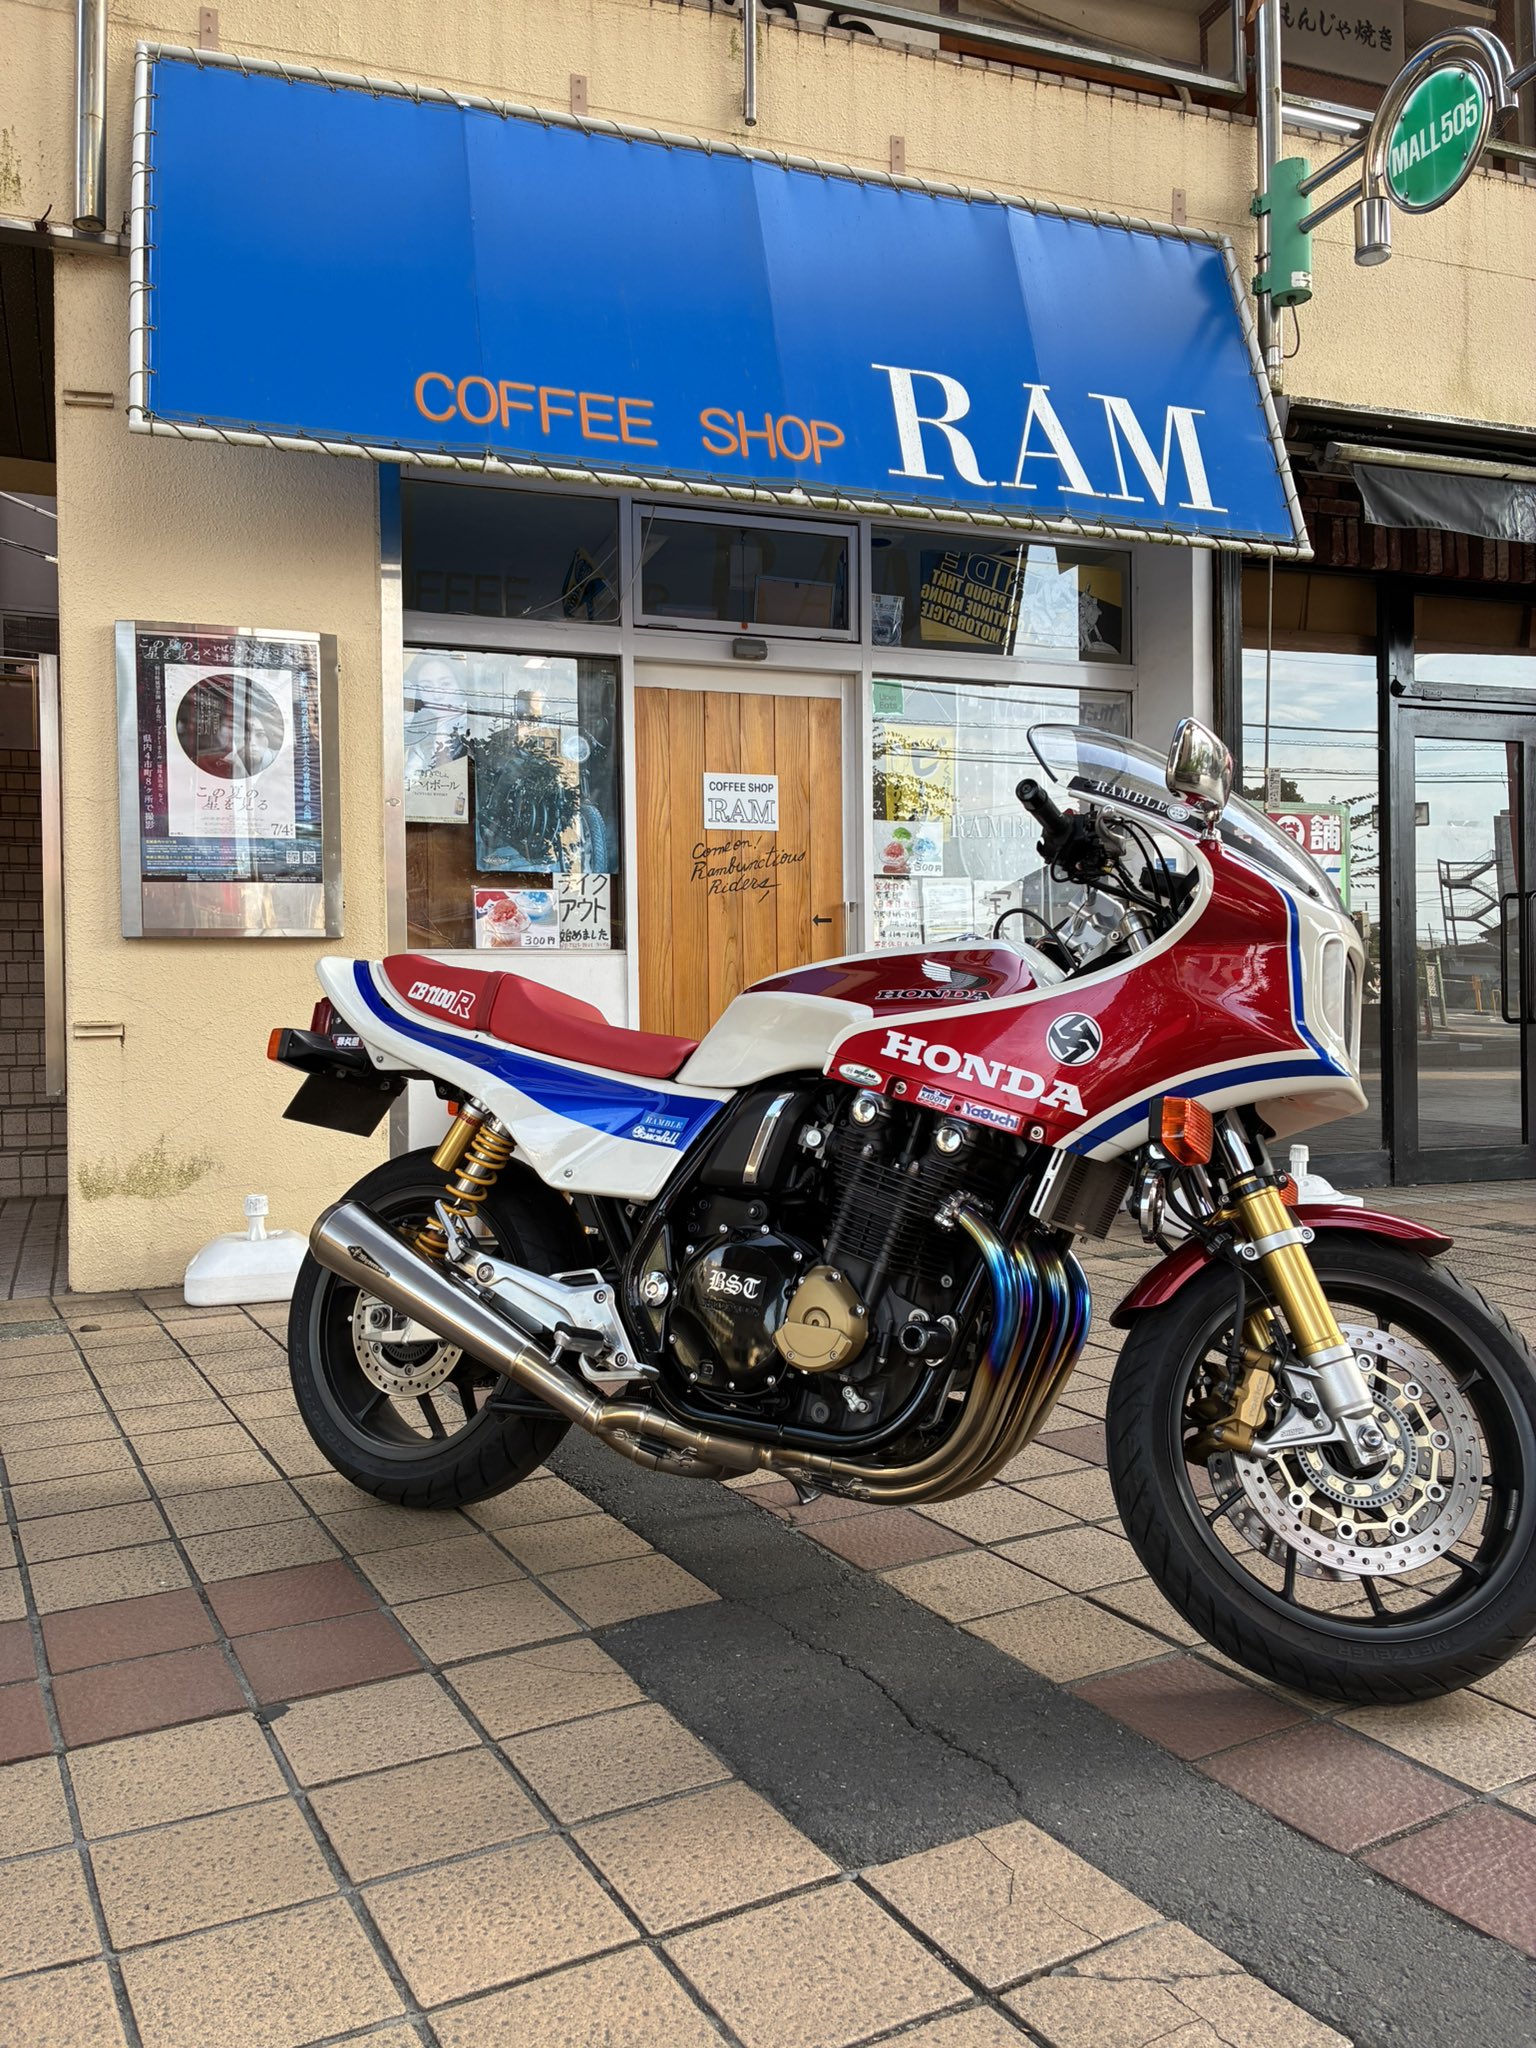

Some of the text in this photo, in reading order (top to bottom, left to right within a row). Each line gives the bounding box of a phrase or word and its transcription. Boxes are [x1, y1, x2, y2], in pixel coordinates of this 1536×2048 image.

[1280, 1, 1393, 52] もんじゃ焼き
[414, 362, 1229, 513] COFFEE SHOP RAM
[879, 701, 898, 711] Eats
[709, 781, 774, 793] COFFEE SHOP
[1094, 780, 1168, 813] RAMBLE
[708, 797, 776, 825] RAM
[692, 842, 733, 860] Come
[690, 846, 807, 882] Rambunctious
[558, 873, 608, 895] テイク
[559, 897, 607, 924] アウト
[524, 935, 556, 945] 300円
[559, 928, 609, 944] 始めました
[407, 981, 476, 1020] CB1100R
[875, 987, 992, 1001] HONDA
[880, 1030, 1088, 1117] HONDA
[920, 1092, 948, 1105] KADOYA
[644, 1115, 684, 1130] RAMBLE
[964, 1103, 1020, 1129] Yaguchi
[705, 1269, 762, 1299] BST
[1336, 1638, 1451, 1663] METZELER
